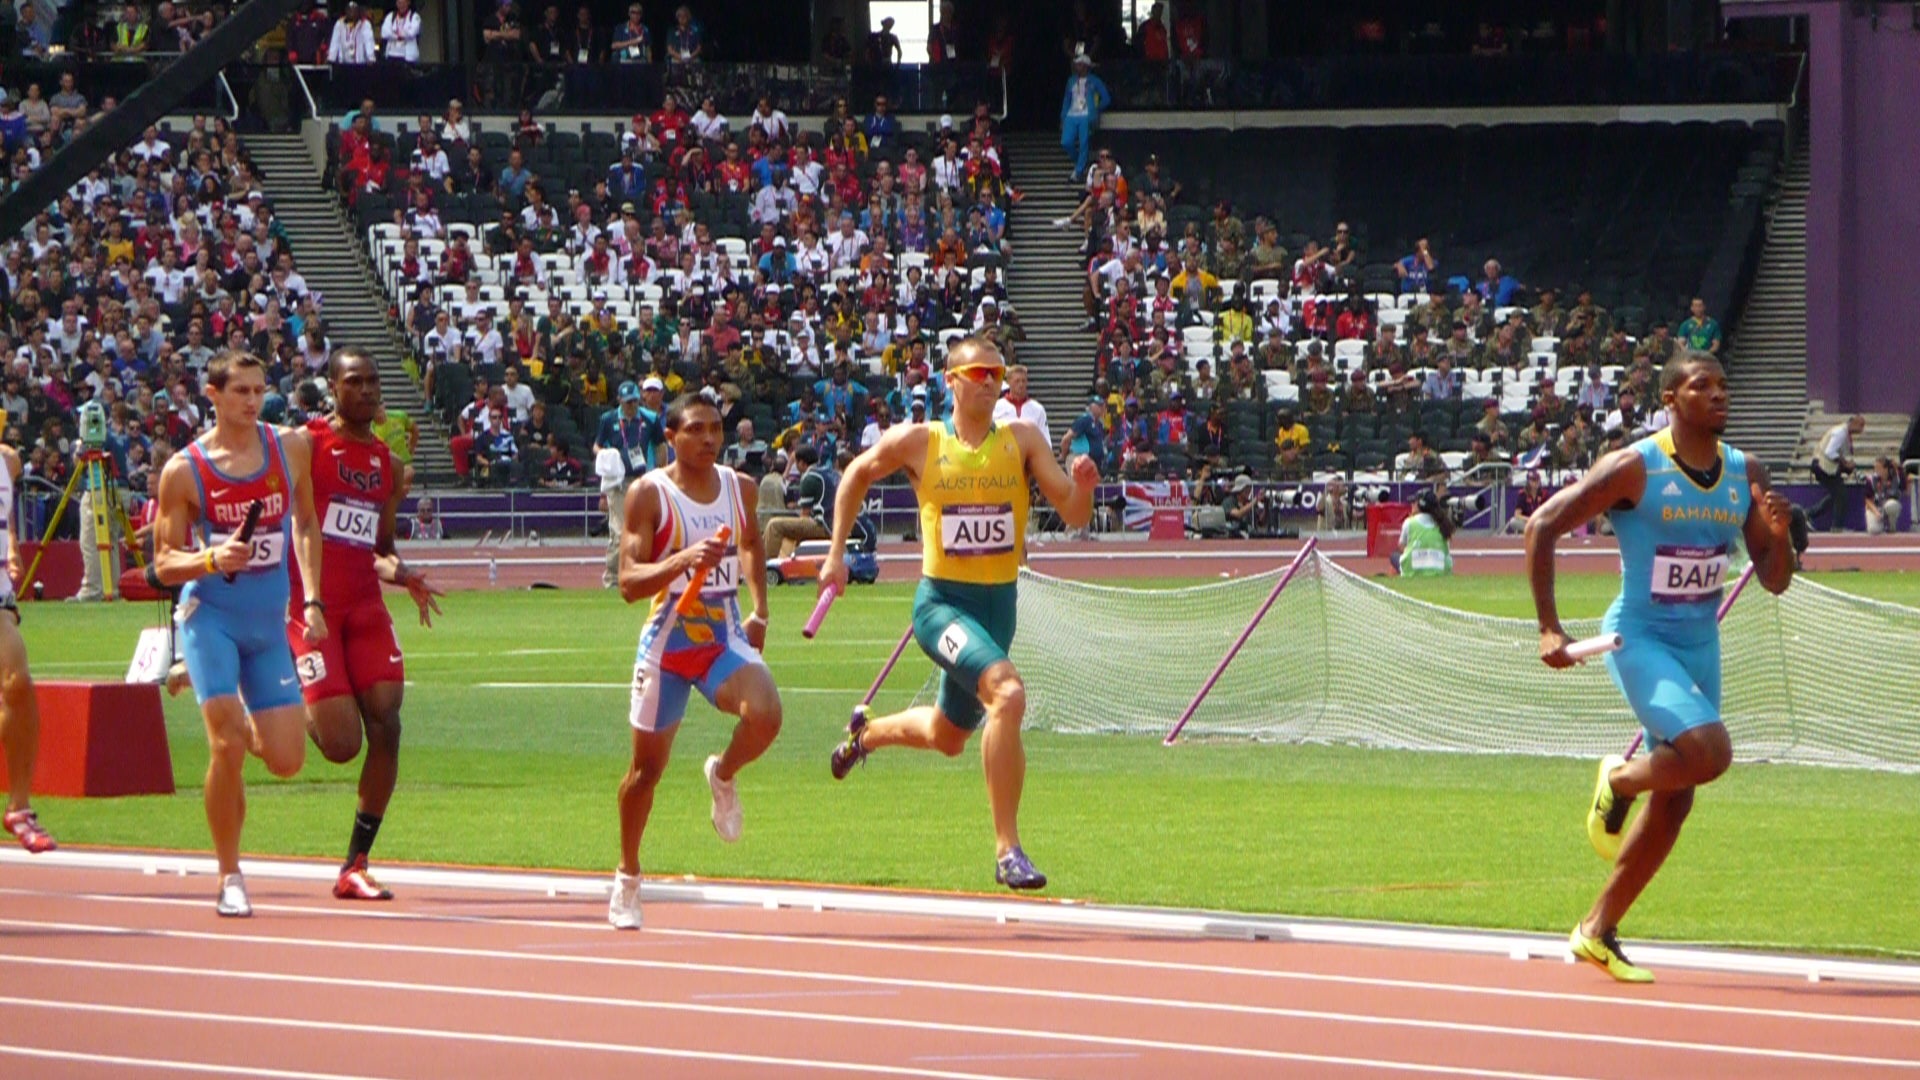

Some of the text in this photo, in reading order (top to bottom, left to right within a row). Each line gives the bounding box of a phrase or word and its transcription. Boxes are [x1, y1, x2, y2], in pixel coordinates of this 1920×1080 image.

[337, 459, 382, 491] USA
[934, 475, 1018, 490] AUSTRALIA
[214, 493, 283, 522] RUSIA
[335, 509, 373, 538] USA
[690, 514, 726, 529] VEN
[953, 519, 1006, 544] AUS
[1667, 562, 1721, 589] BAH
[945, 634, 959, 654] 4
[304, 657, 317, 680] 3
